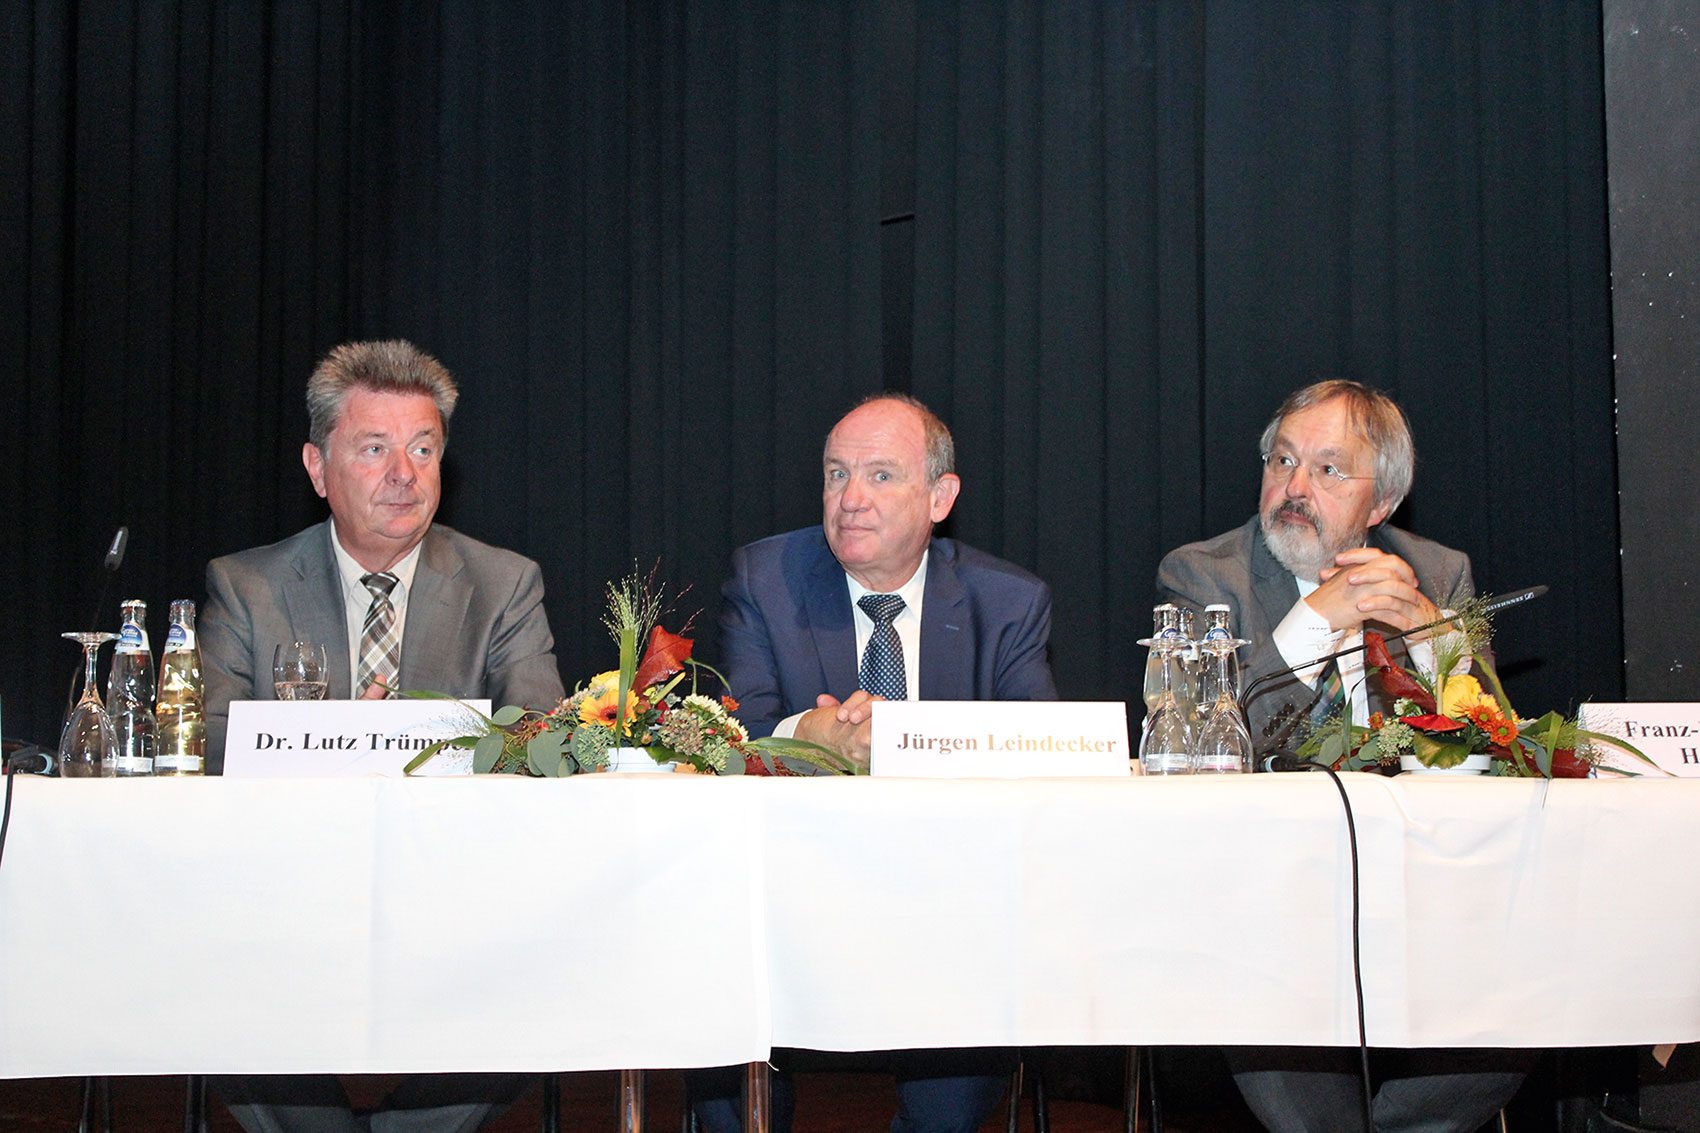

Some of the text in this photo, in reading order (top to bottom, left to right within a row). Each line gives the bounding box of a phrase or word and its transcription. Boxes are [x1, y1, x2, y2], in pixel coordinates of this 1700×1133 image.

[1624, 720, 1700, 737] Franz-
[255, 732, 470, 755] Dr. Lutz Trüm
[897, 733, 1117, 754] Jürgen Leindecker
